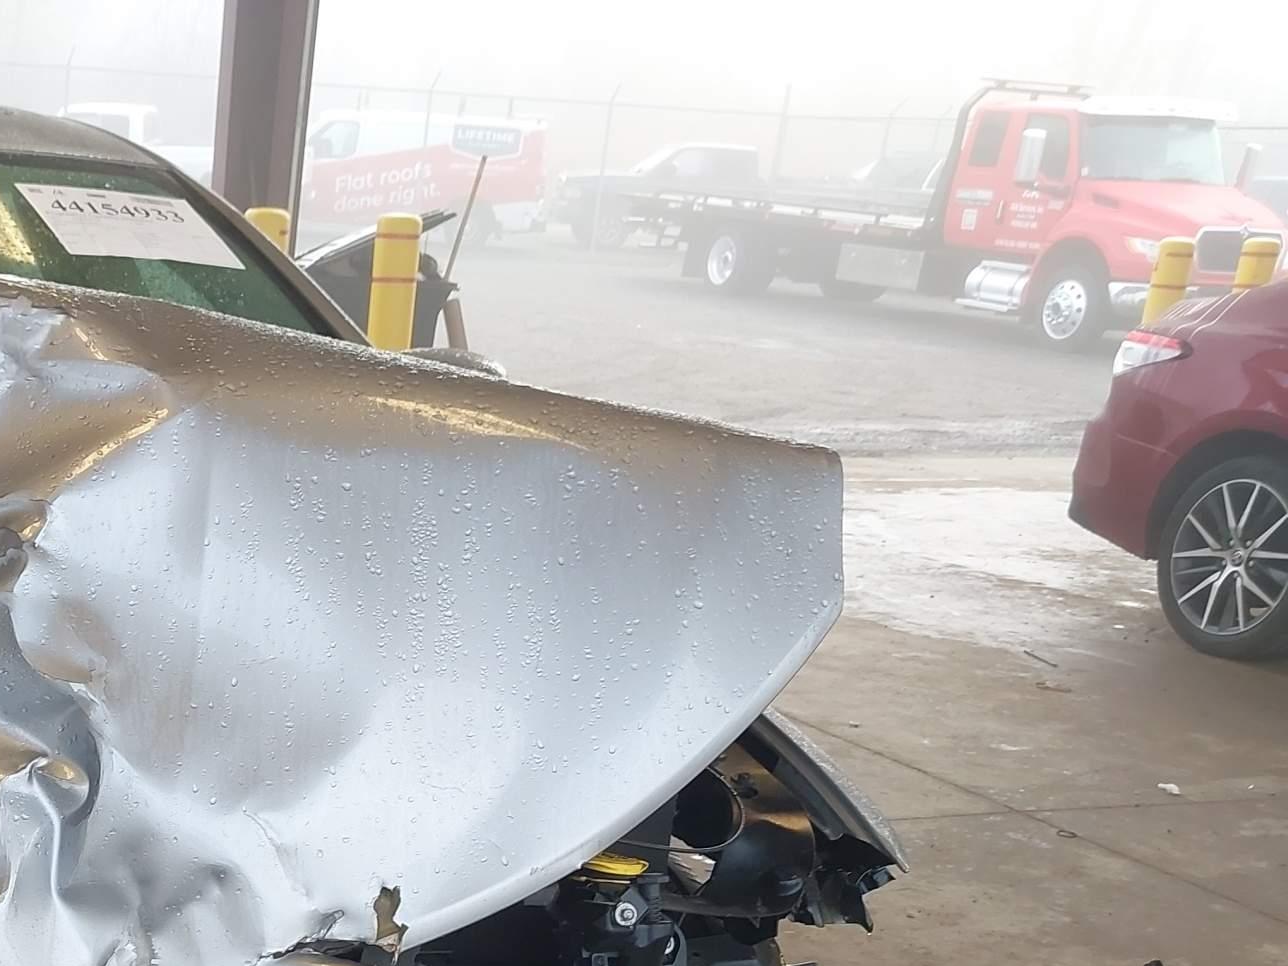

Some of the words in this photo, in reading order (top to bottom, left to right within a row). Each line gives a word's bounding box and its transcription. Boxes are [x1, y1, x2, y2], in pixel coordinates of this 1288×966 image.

[335, 172, 374, 193] Flat
[379, 160, 432, 185] roofs
[51, 199, 185, 224] 44154933
[333, 193, 384, 213] done
